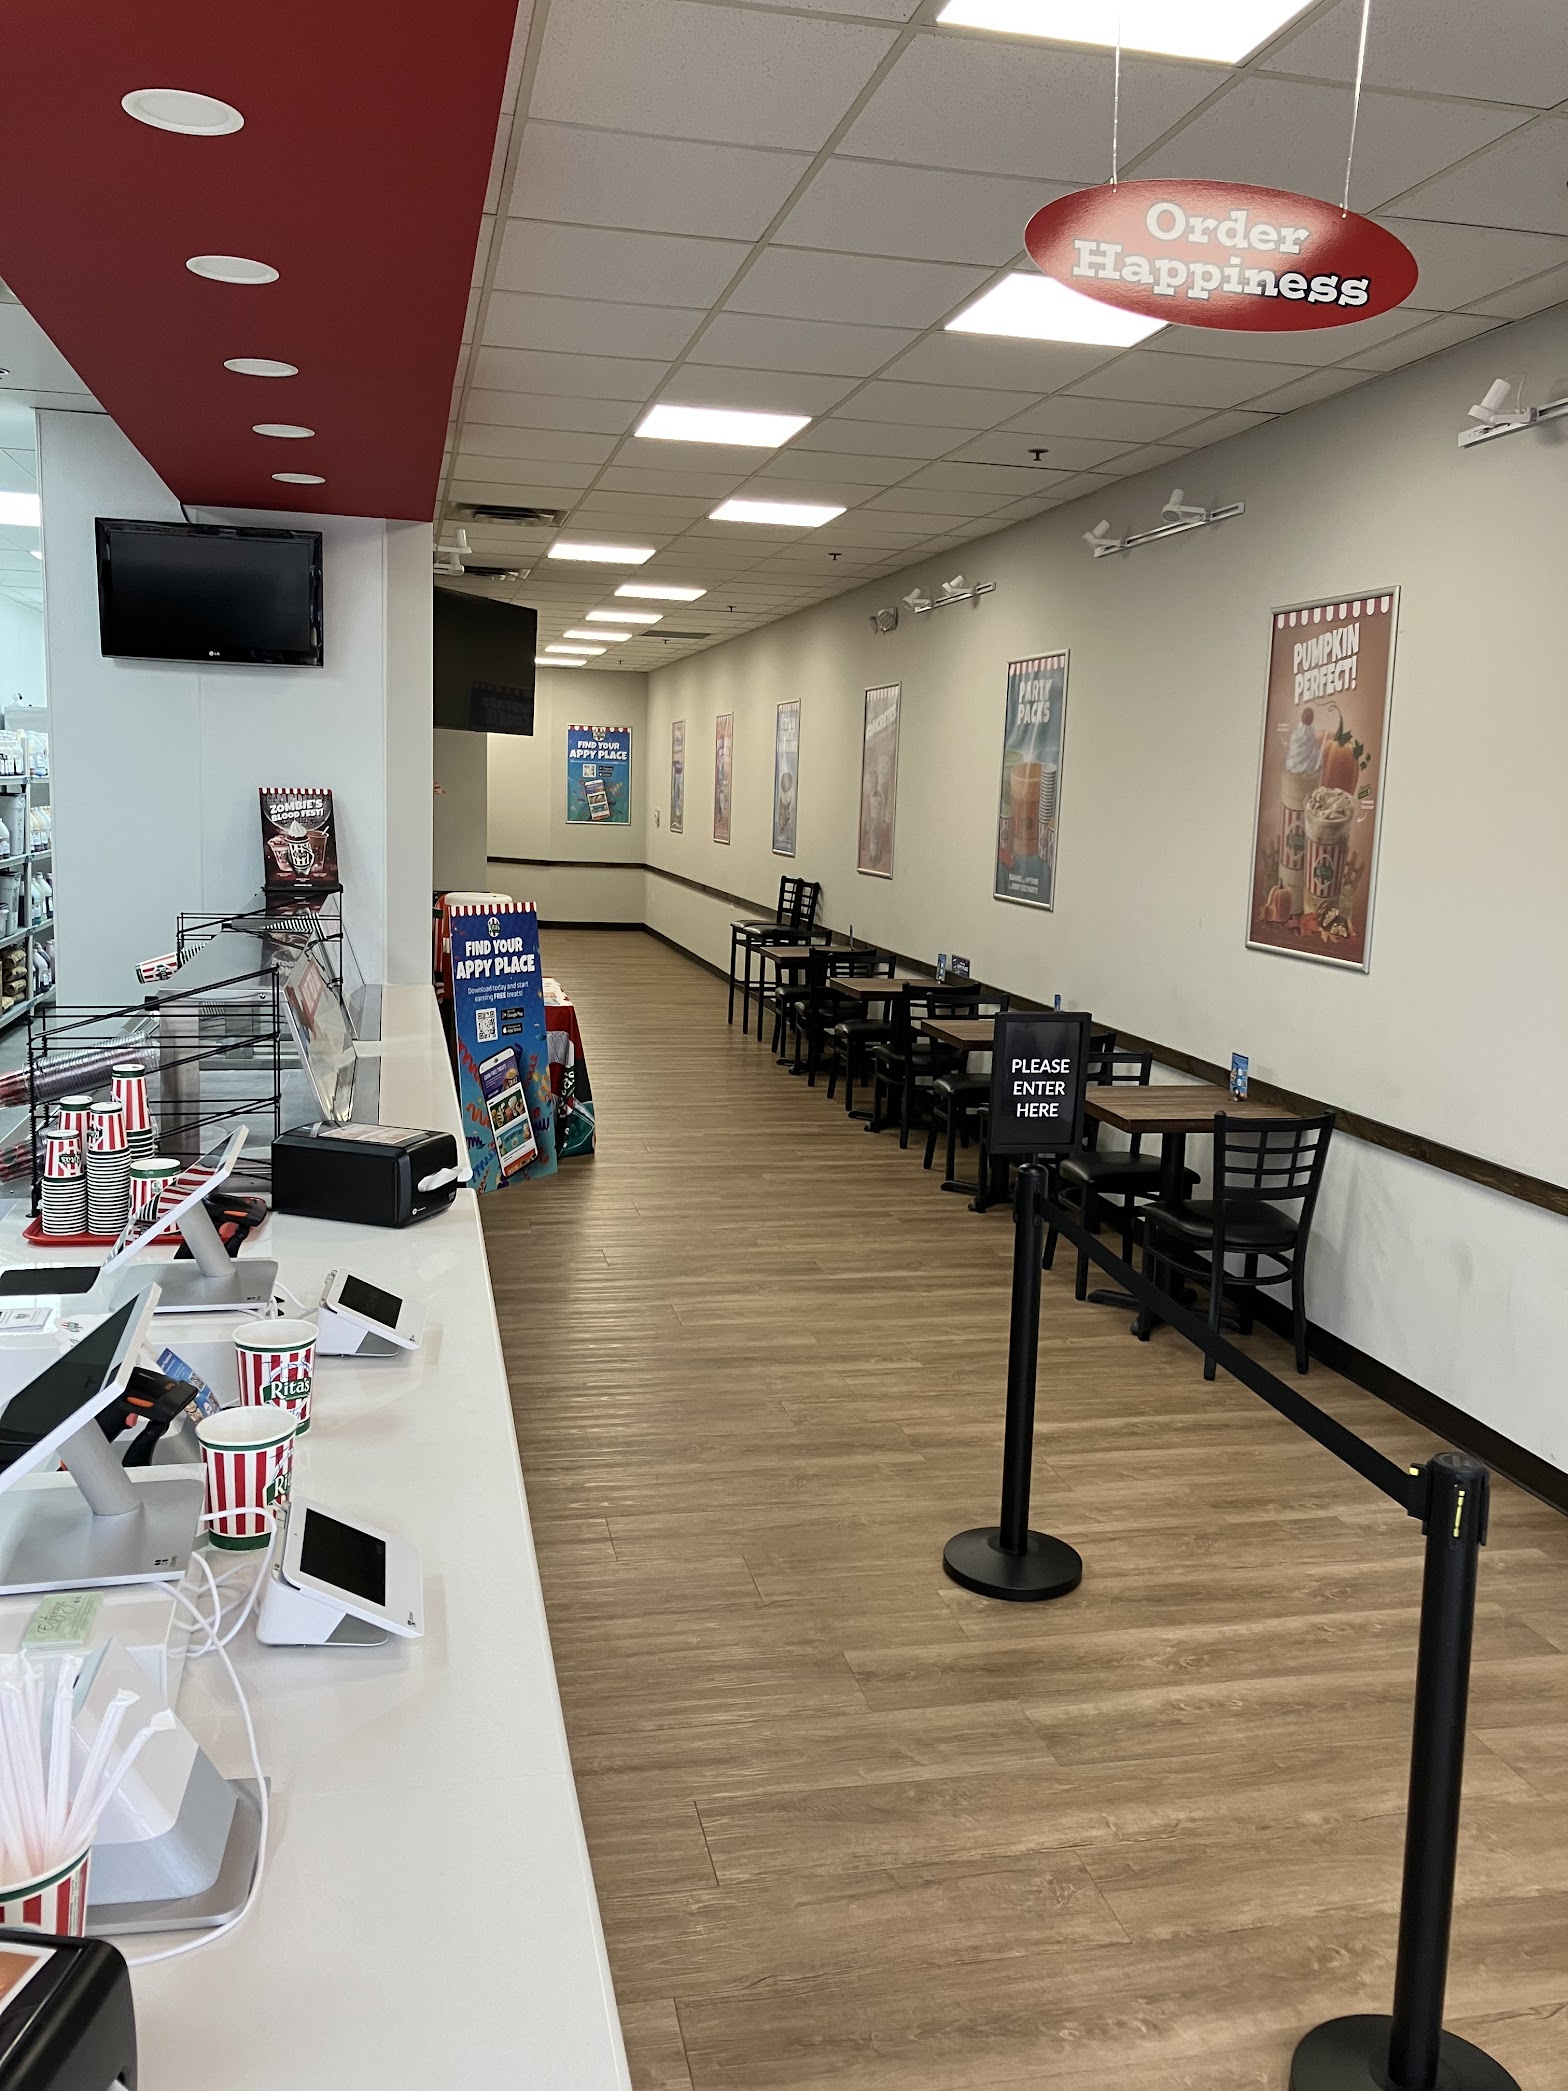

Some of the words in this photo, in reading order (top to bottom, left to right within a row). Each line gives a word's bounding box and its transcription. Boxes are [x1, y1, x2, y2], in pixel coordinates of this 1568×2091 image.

[1145, 201, 1310, 255] Order
[1072, 239, 1370, 307] Happiness
[1293, 622, 1360, 674] PUMPKIN
[1294, 655, 1357, 704] PERFECT!
[1018, 679, 1053, 704] PARTY
[1017, 701, 1050, 725] PACKS
[577, 741, 596, 749] FIND
[598, 742, 620, 750] YOUR
[569, 750, 598, 759] APPY
[598, 750, 628, 760] PLACE
[269, 799, 323, 815] ZOMBIE'S
[271, 811, 300, 822] BLOOD
[301, 808, 324, 817] FEST!
[465, 940, 491, 957] FIND
[493, 937, 523, 954] YOUR
[456, 958, 492, 979] APPY
[494, 954, 536, 976] PLACE
[468, 985, 492, 995] Download
[492, 984, 507, 992] today
[475, 994, 494, 1003] earning
[493, 992, 507, 1000] FREE
[507, 990, 524, 998] treats!
[1011, 1058, 1070, 1074] PLEASE
[1013, 1081, 1066, 1096] ENTER
[1016, 1103, 1060, 1118] HERE
[271, 1377, 310, 1399] Rita's
